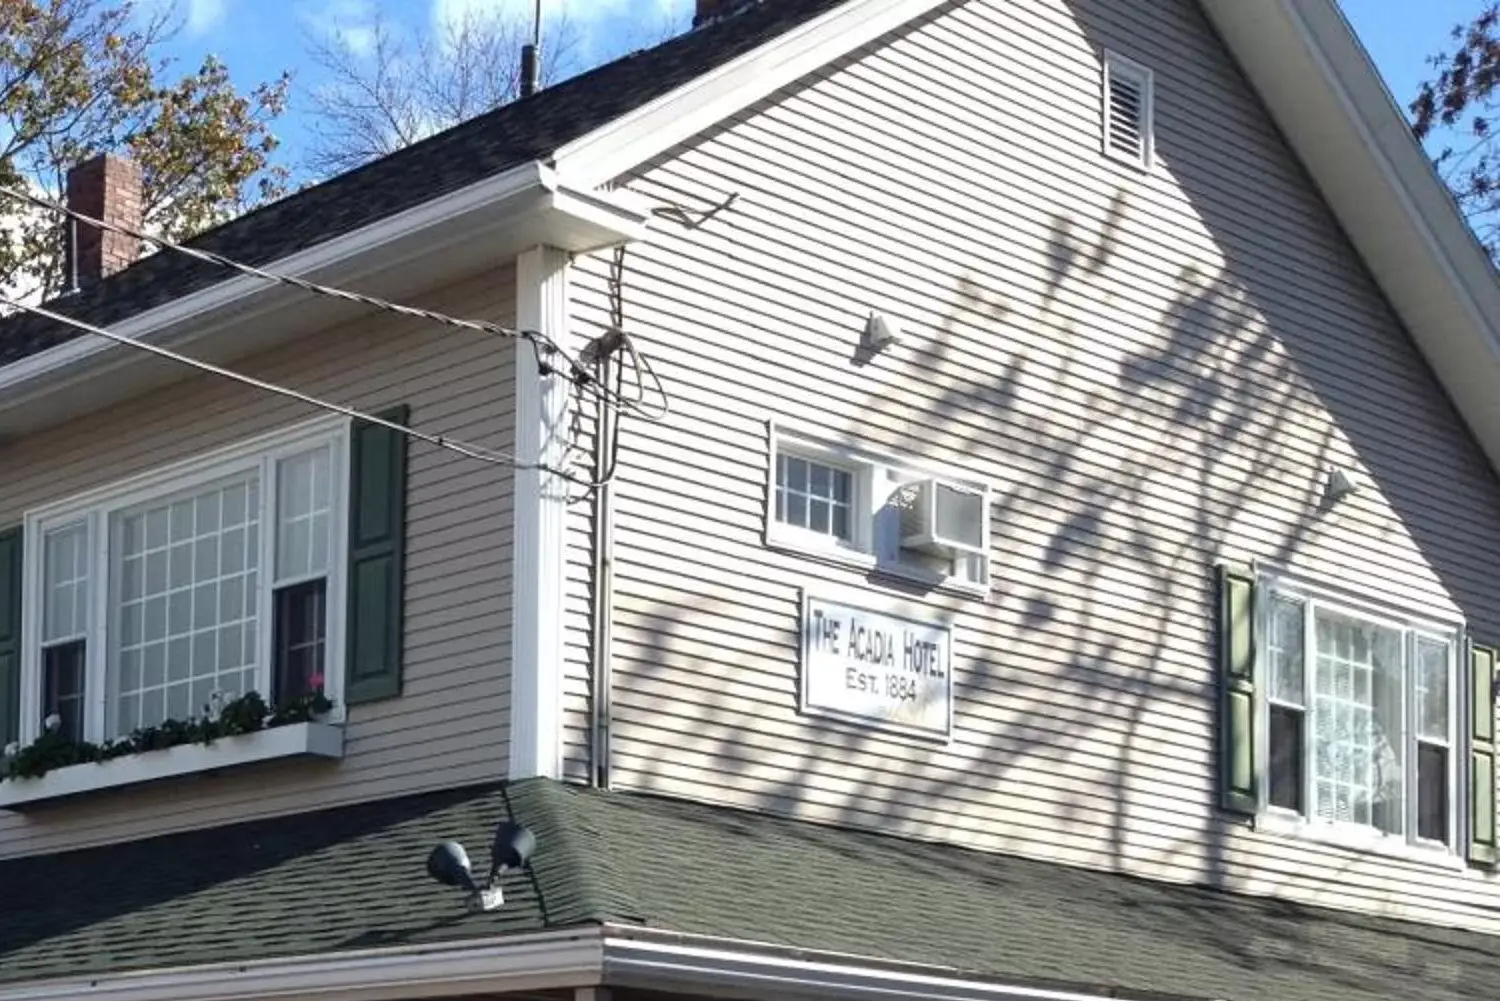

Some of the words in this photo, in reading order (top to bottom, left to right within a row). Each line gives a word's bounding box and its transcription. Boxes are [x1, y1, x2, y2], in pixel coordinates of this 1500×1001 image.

[813, 610, 841, 654] THE
[848, 618, 895, 666] ACADIA
[903, 630, 944, 678] HOTEL
[845, 667, 879, 694] EST.
[885, 674, 917, 702] 1884
